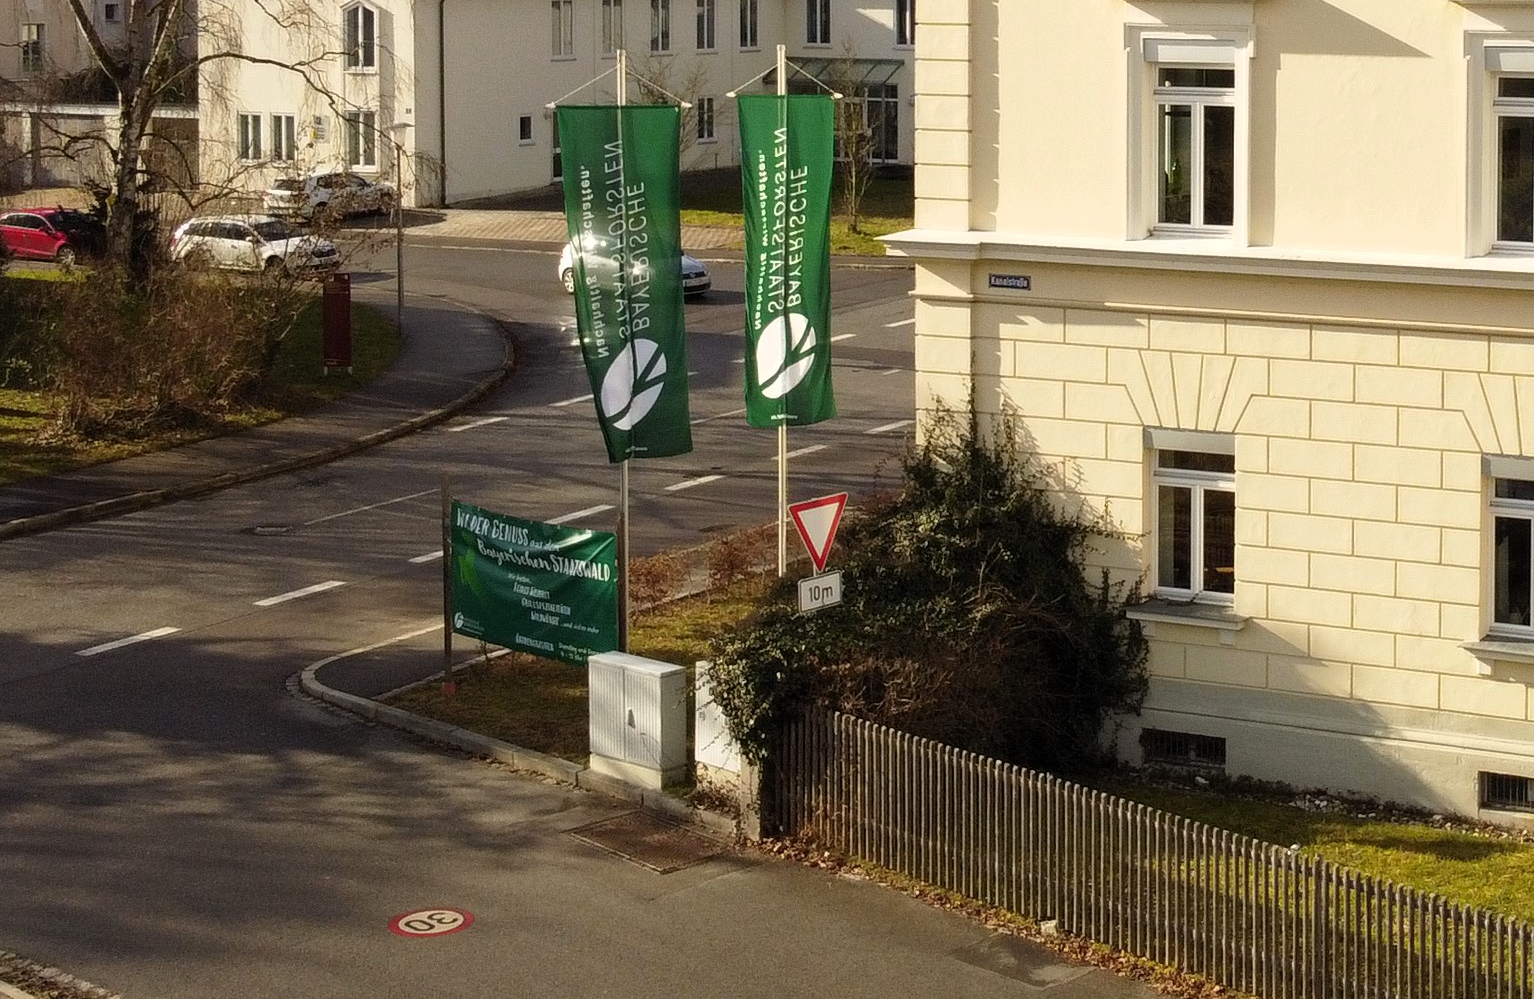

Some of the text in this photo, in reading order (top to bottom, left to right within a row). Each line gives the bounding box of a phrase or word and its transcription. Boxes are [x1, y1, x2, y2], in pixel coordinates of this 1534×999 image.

[457, 508, 490, 536] WIDER
[491, 519, 529, 546] GENUSS
[477, 538, 551, 571] Bayerischen
[404, 912, 459, 932] 30
